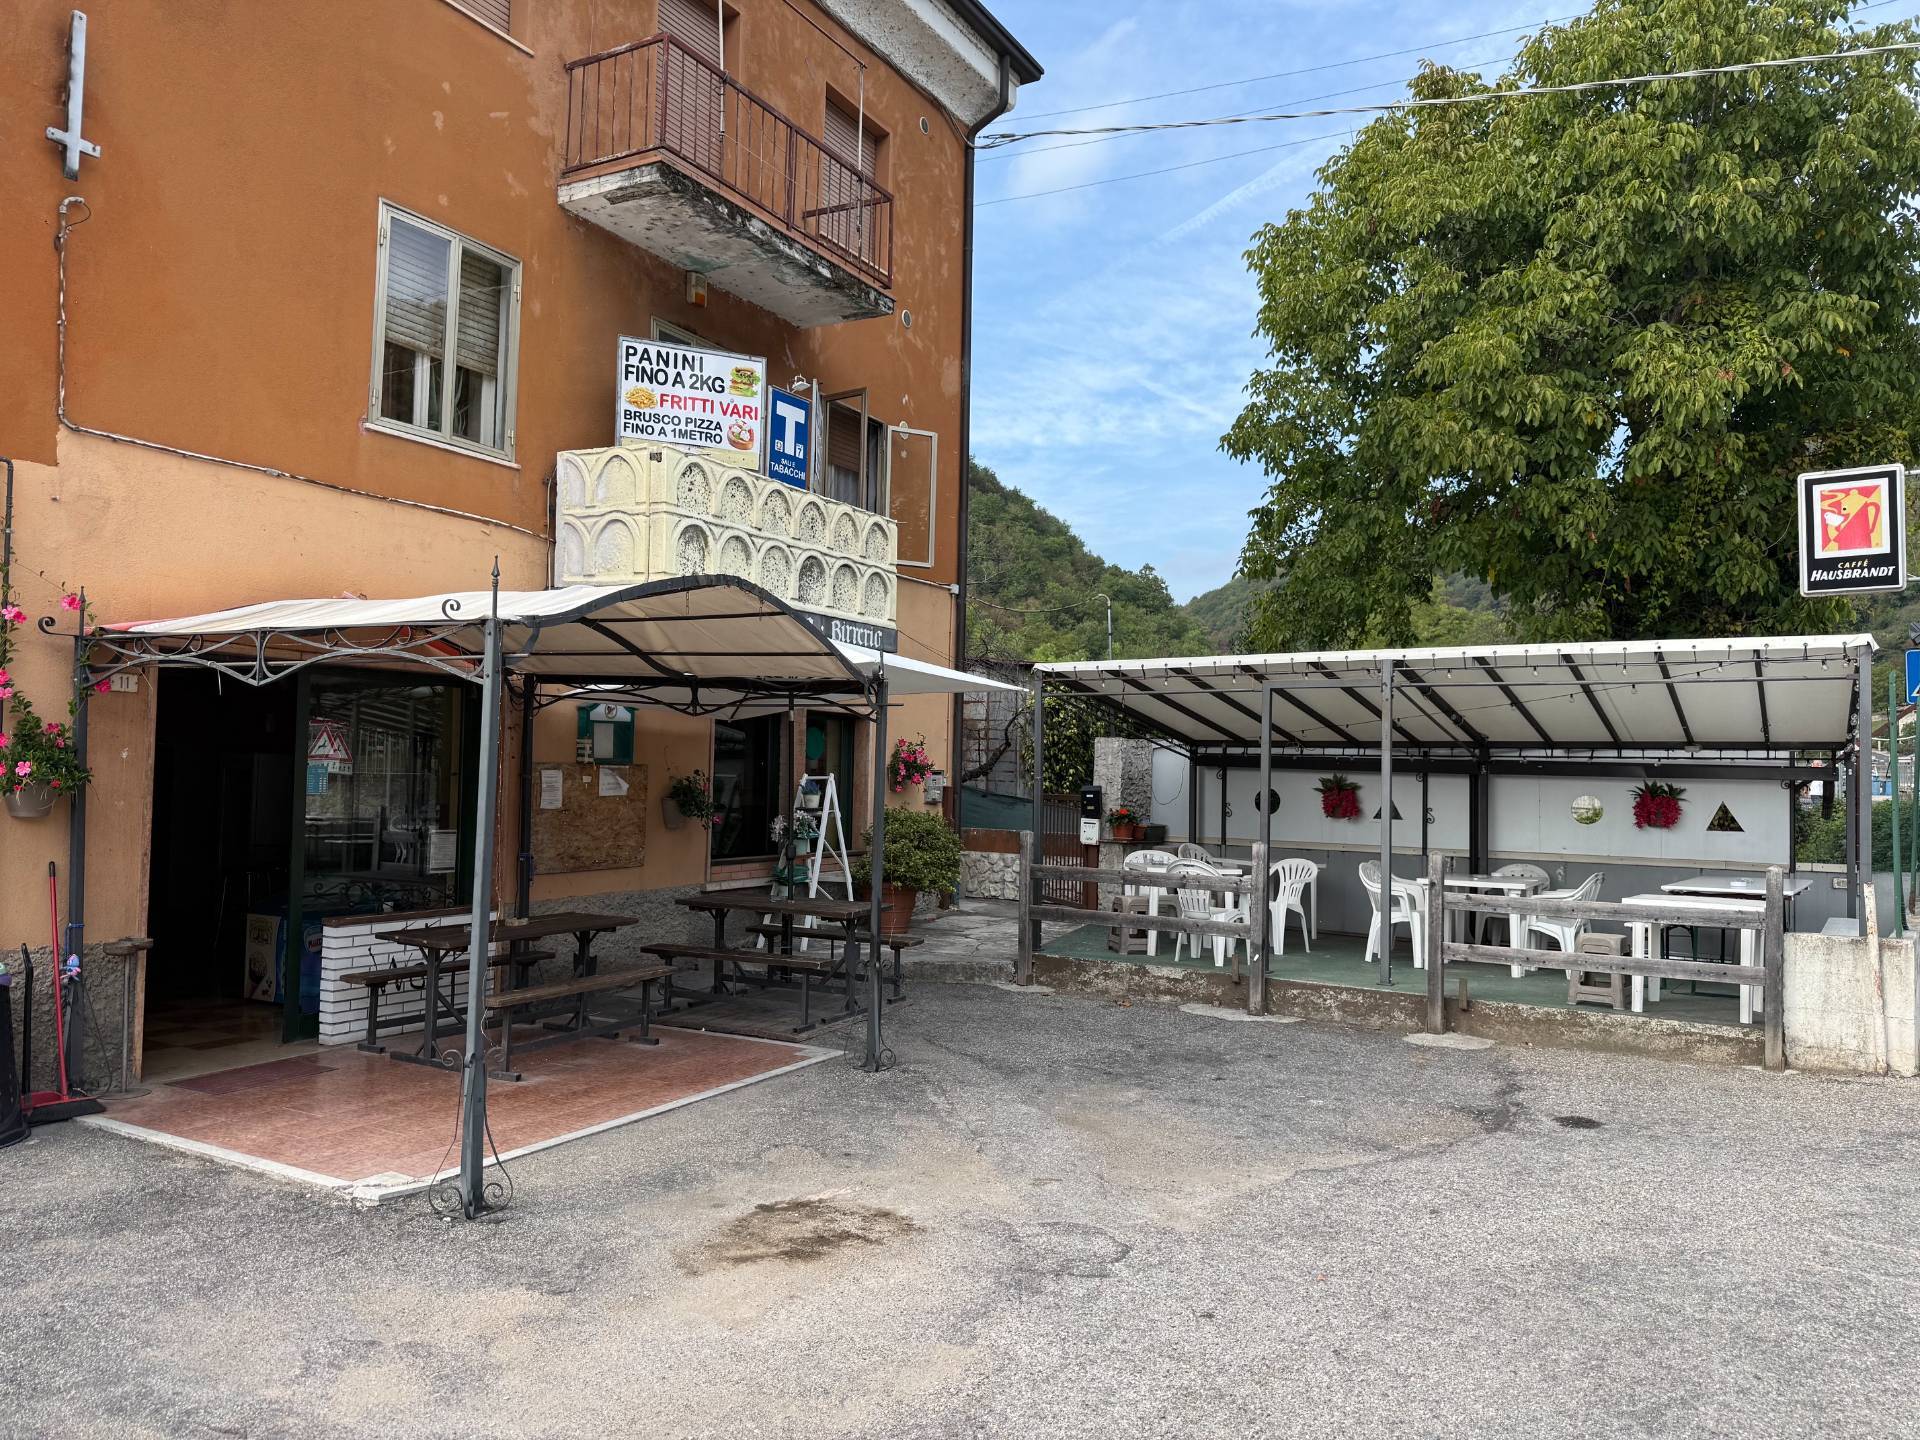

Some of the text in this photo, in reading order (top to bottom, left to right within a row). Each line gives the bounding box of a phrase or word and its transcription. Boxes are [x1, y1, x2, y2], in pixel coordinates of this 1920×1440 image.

[625, 345, 704, 373] PANINI
[624, 364, 726, 394] FINO A 2KG
[659, 393, 759, 421] FRITTI VARI
[623, 409, 723, 433] BRUSCO PIZZA
[623, 421, 723, 444] FINO A 1METRO
[776, 400, 806, 457] T
[770, 461, 806, 480] TABACCHI
[120, 676, 129, 689] 11
